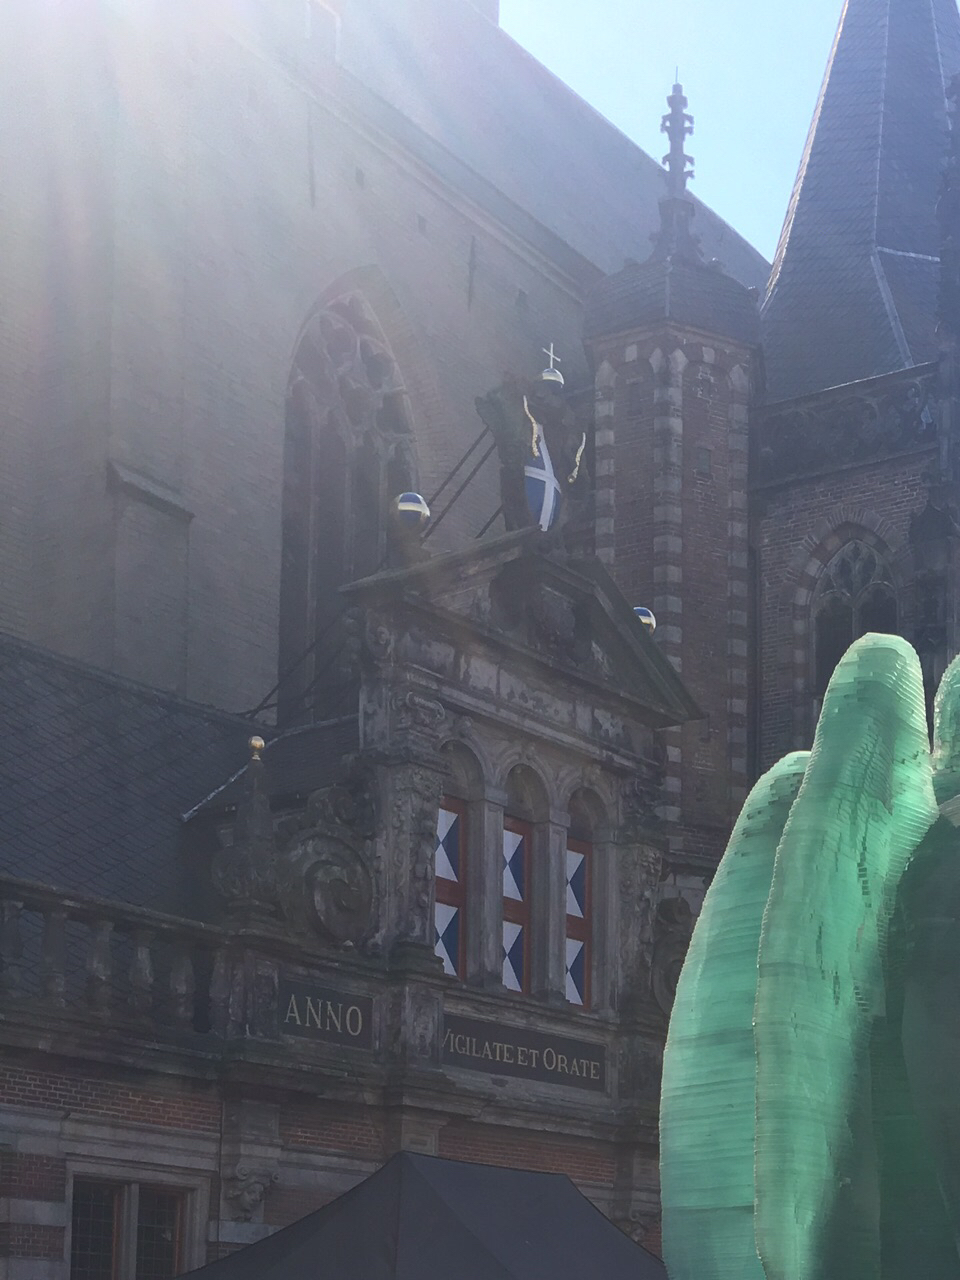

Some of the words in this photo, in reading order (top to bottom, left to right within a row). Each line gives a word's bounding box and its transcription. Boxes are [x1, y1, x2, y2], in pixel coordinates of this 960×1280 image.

[284, 994, 363, 1036] ANNO
[517, 1046, 539, 1068] ET
[543, 1047, 600, 1080] ORATE
